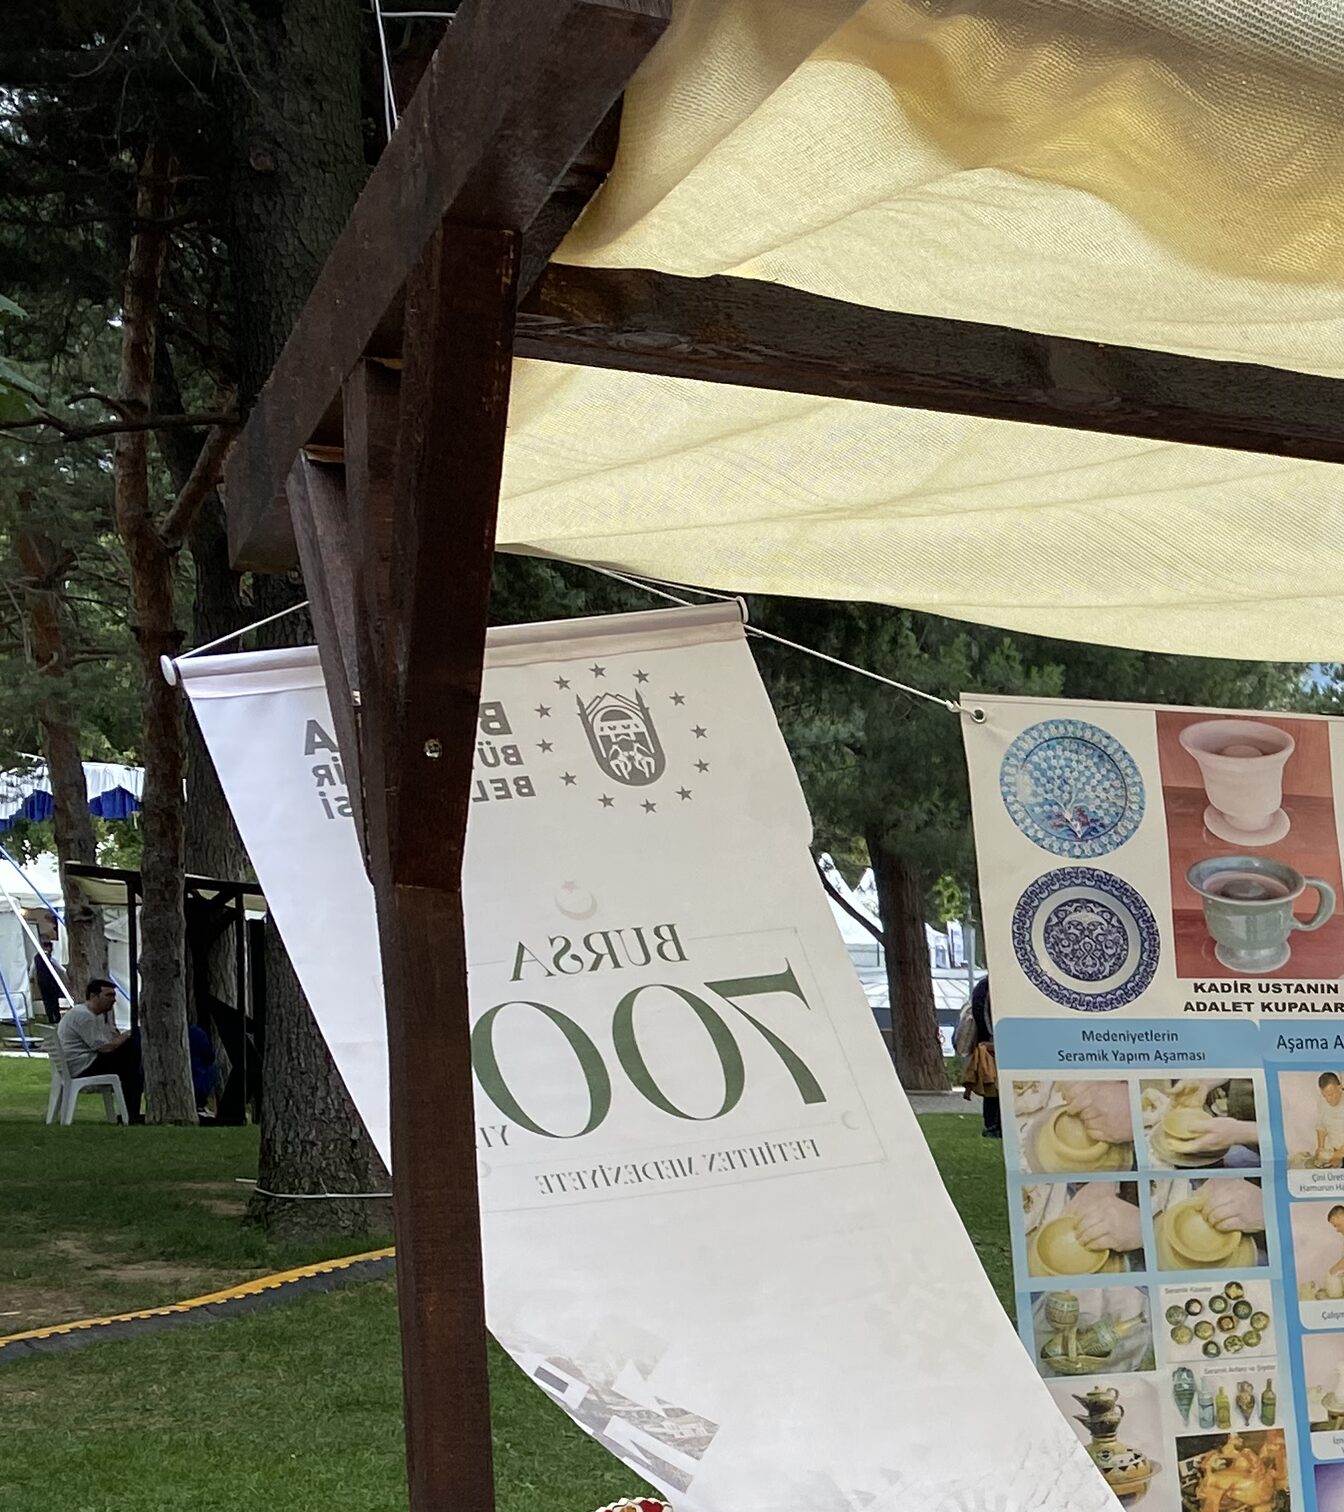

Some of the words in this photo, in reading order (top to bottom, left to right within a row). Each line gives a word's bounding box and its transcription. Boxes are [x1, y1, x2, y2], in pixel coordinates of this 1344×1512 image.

[1193, 980, 1252, 994] KADİR
[1258, 983, 1339, 995] USTANIN
[1184, 1002, 1254, 1013] ADALET
[1081, 1030, 1179, 1045] Medeniyetlerin
[1276, 1035, 1328, 1053] Aşama
[1058, 1049, 1109, 1062] Seramik
[1112, 1050, 1150, 1064] Yapım
[1154, 1050, 1206, 1063] Aşaması
